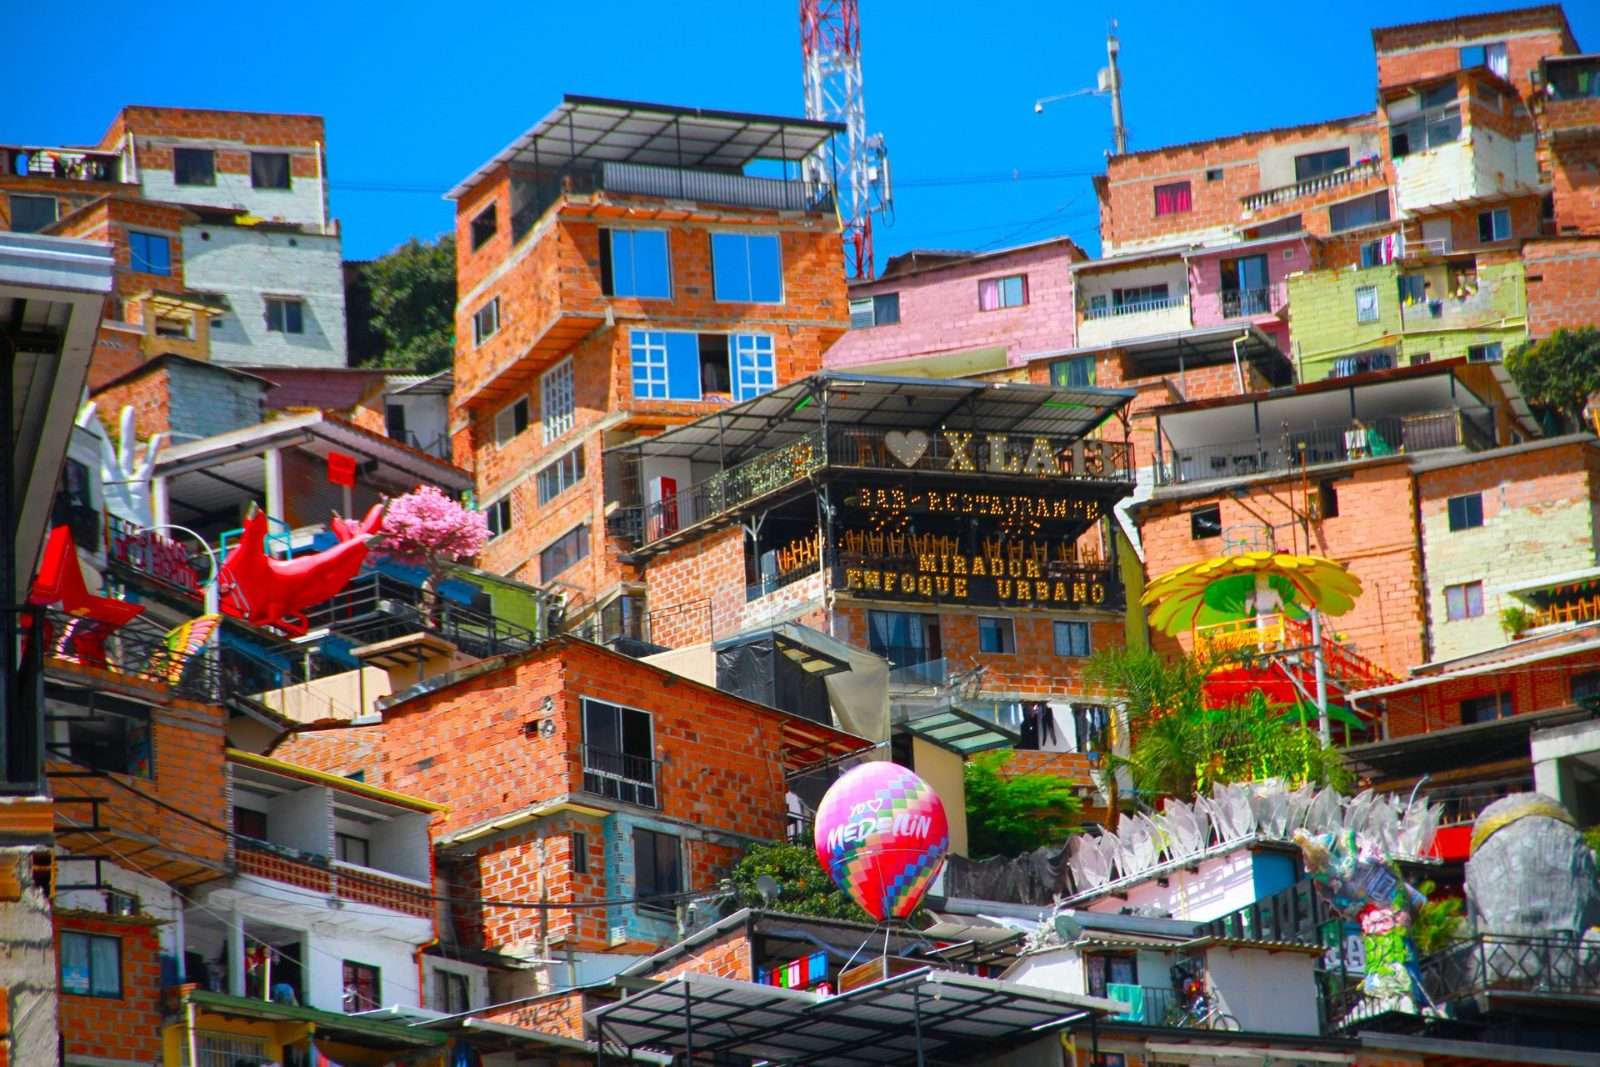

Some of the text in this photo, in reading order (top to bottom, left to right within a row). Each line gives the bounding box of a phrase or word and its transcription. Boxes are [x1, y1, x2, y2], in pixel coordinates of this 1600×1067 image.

[918, 554, 1041, 578] MIRADOR
[846, 568, 1105, 604] ENFOQUE URBANO
